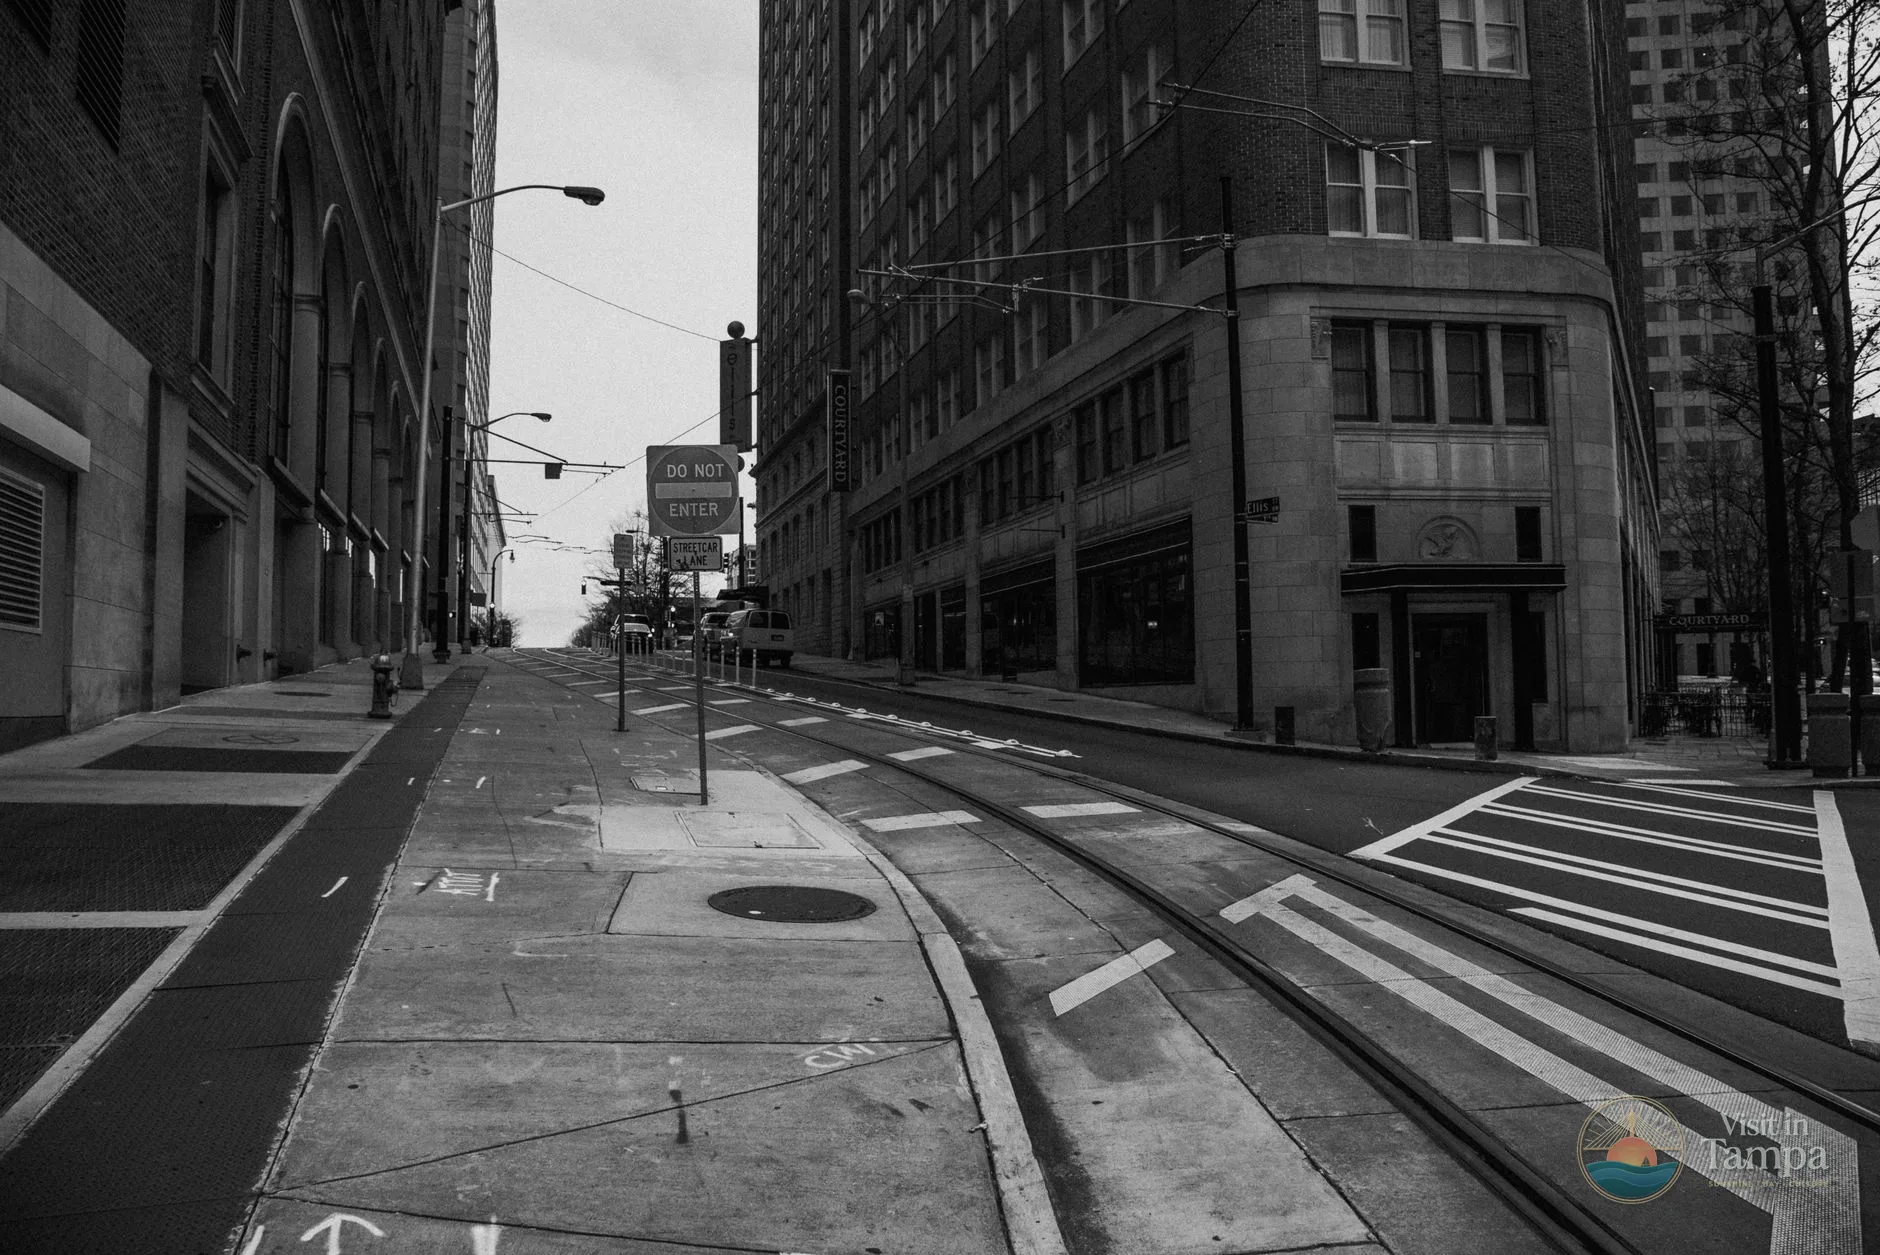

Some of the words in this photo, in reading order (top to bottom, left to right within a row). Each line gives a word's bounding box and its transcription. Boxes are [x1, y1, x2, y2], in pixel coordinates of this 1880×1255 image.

[834, 385, 847, 482] COURTYARD
[667, 464, 688, 478] DO
[694, 463, 725, 478] NOT
[669, 502, 719, 517] ENTER
[673, 542, 718, 553] STREETCAR
[682, 555, 708, 566] LANE
[1668, 614, 1750, 626] COURTYARD
